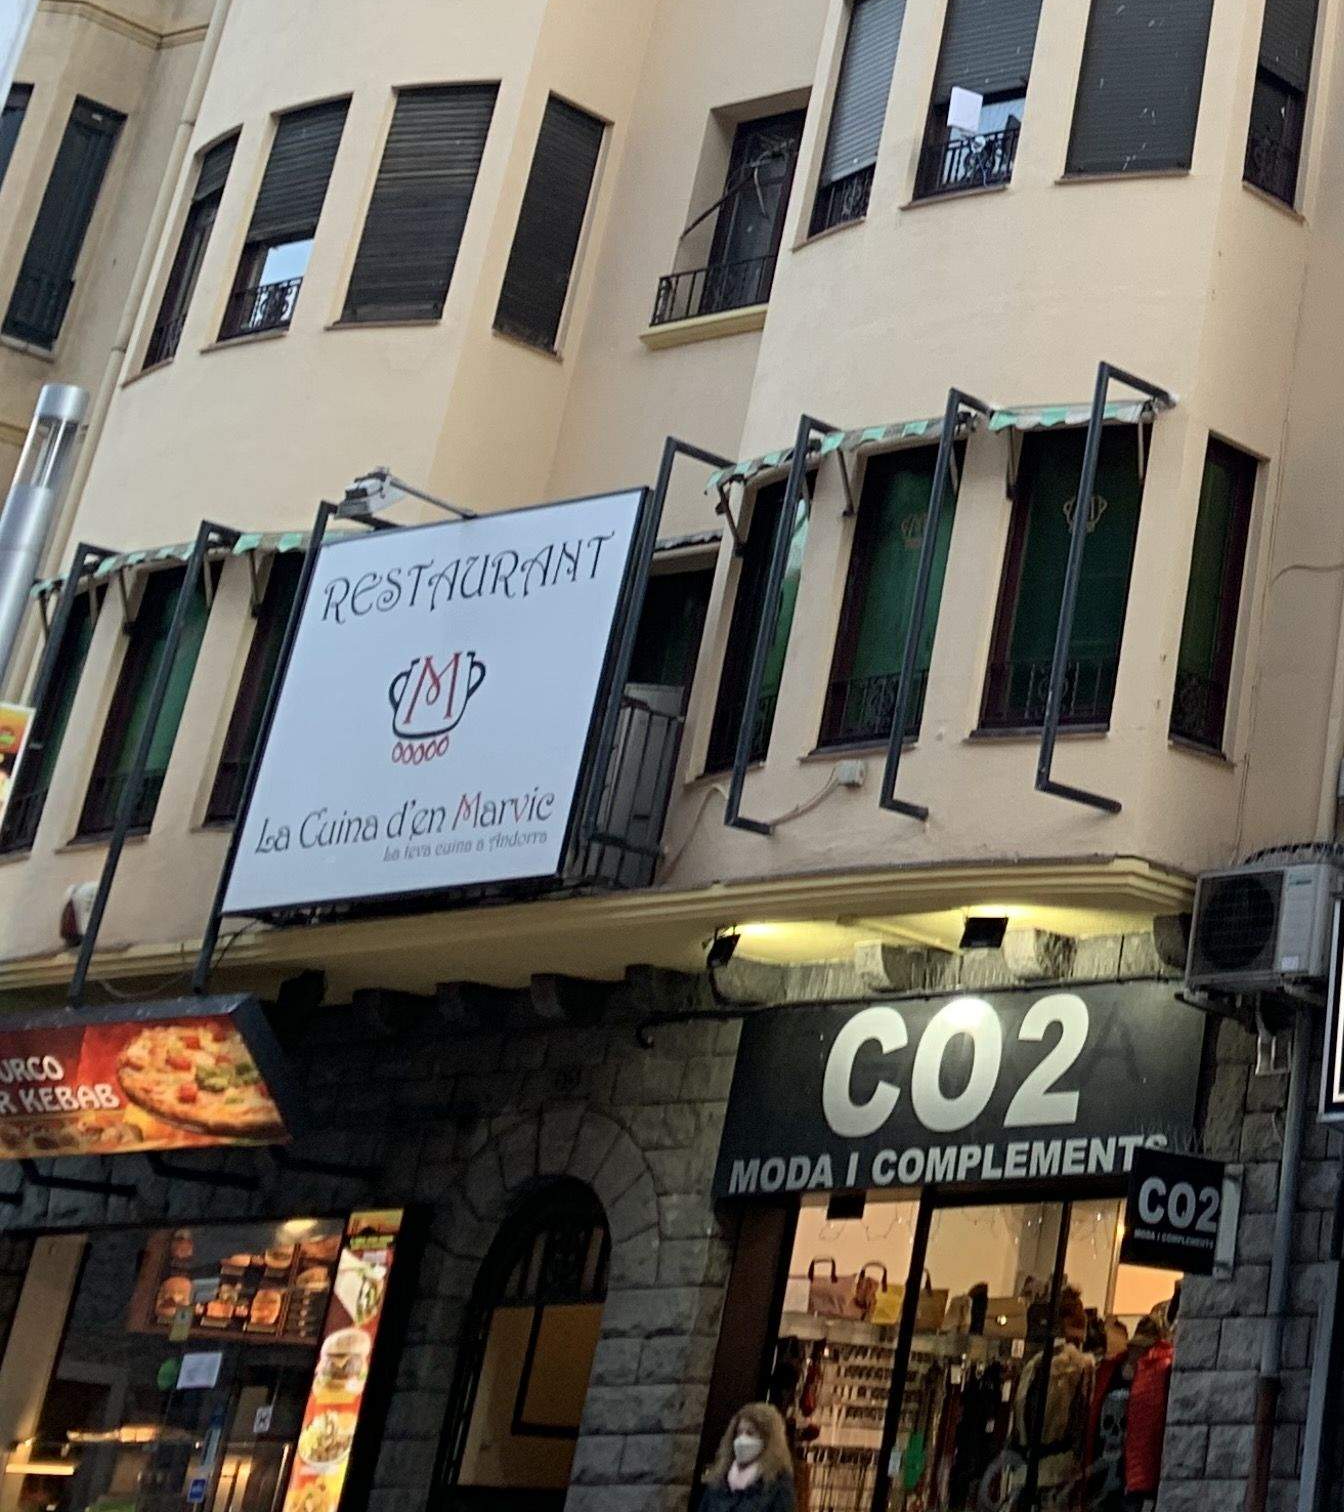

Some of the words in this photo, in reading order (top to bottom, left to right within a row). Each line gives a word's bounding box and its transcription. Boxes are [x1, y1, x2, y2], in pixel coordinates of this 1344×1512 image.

[321, 530, 616, 625] RESTAURANT
[254, 817, 291, 854] La
[299, 806, 379, 849] Cuina
[386, 799, 447, 840] d'en
[451, 786, 556, 832] Marvic
[821, 992, 1091, 1139] CO2
[18, 1082, 120, 1114] KEBAB
[728, 1153, 835, 1195] MODA
[844, 1150, 860, 1187] I
[1137, 1175, 1220, 1233] CO2
